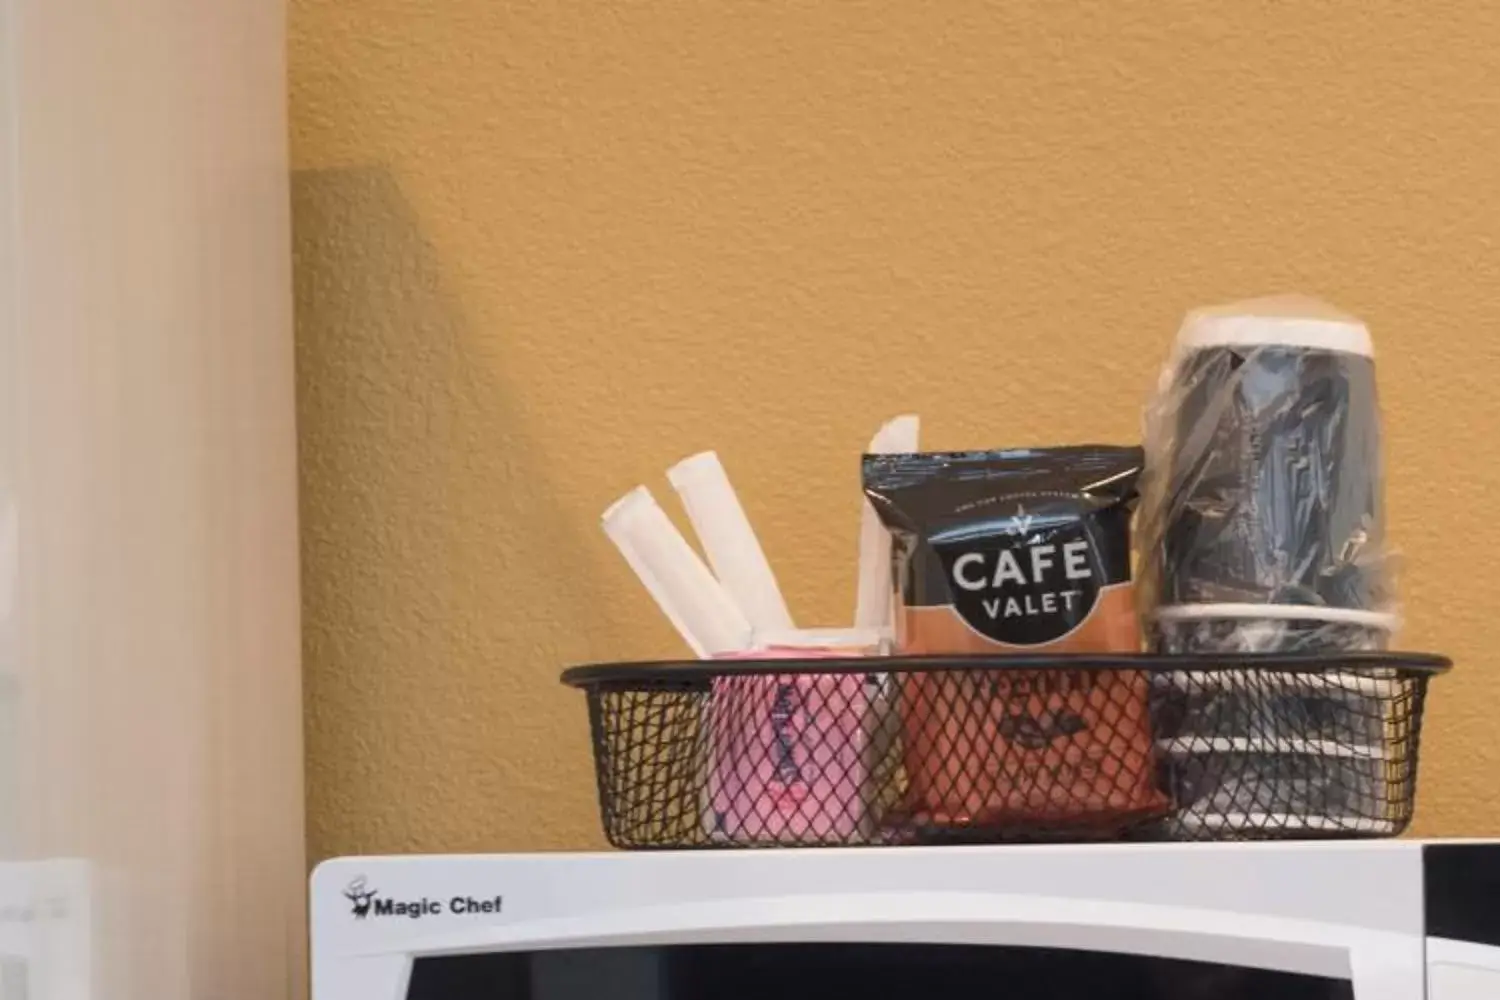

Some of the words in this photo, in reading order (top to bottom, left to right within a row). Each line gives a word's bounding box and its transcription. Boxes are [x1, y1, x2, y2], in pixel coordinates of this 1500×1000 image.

[982, 591, 1076, 620] VALET
[375, 898, 441, 918] Magic
[449, 896, 502, 914] Chef
